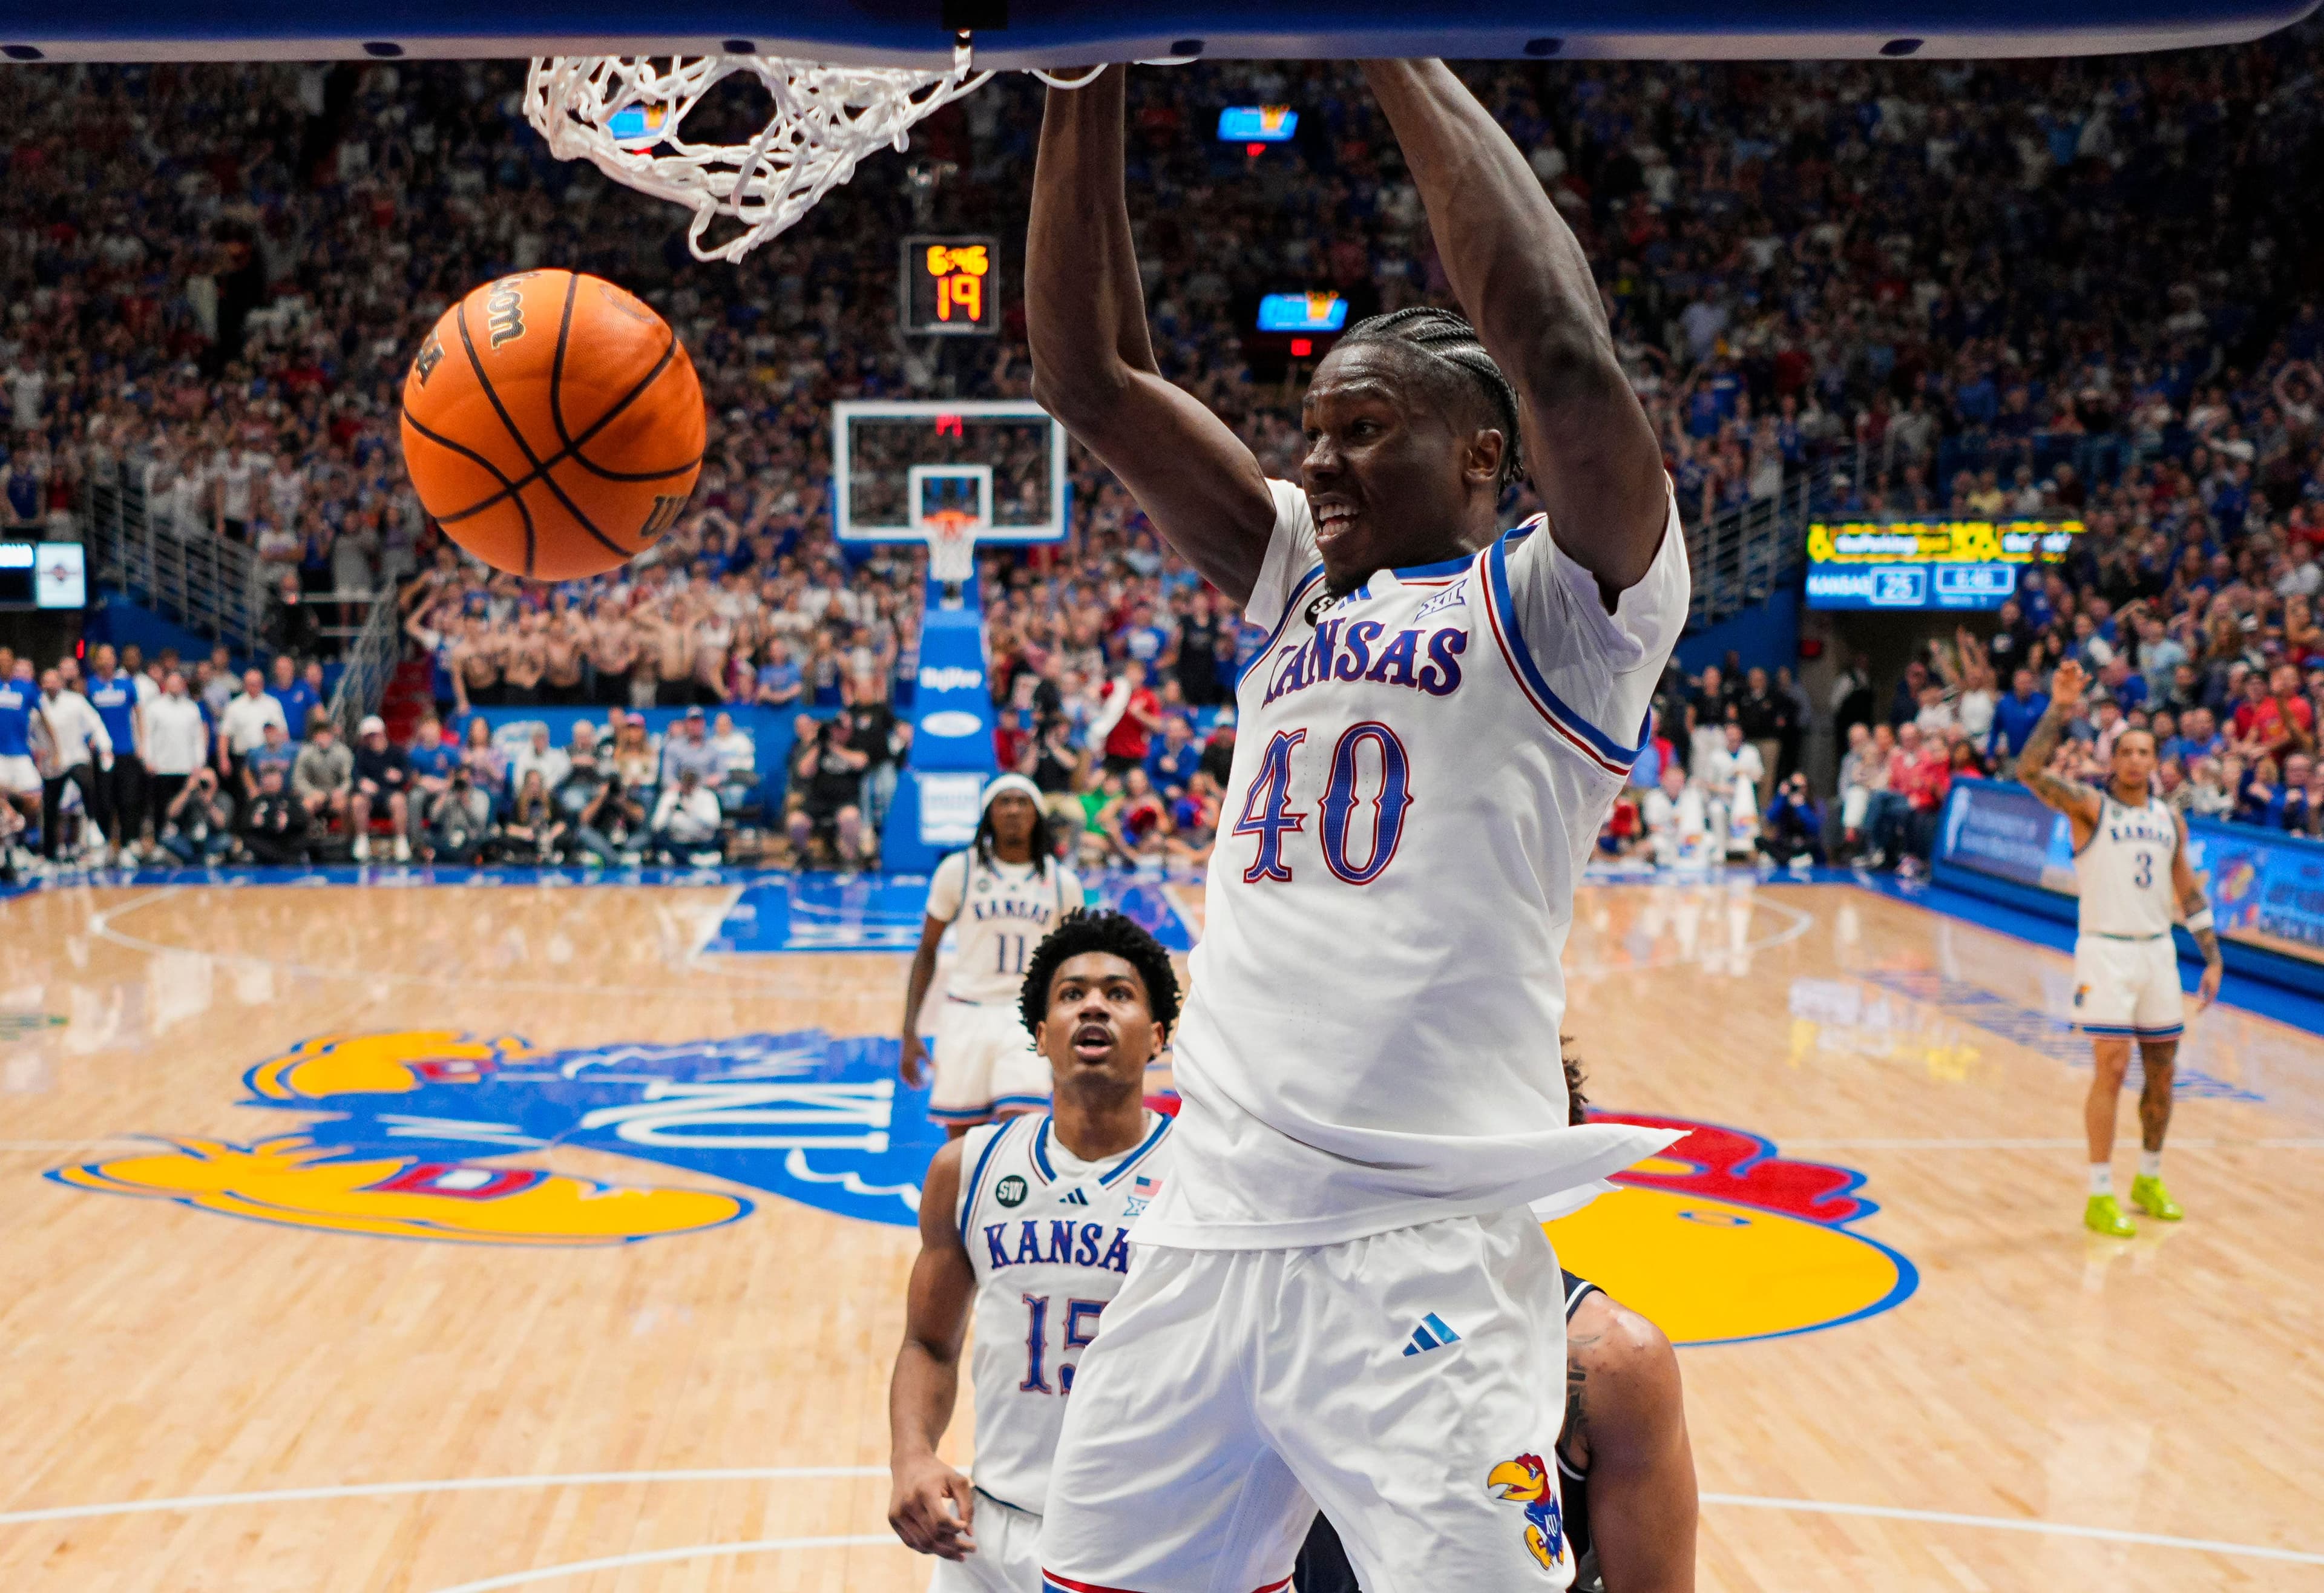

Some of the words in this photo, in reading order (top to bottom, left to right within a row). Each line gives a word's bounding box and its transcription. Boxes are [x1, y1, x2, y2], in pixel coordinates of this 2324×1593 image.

[937, 275, 981, 321] 19
[1882, 572, 1913, 600] 25
[1232, 721, 1414, 885] 40
[2134, 850, 2153, 888] 3
[997, 933, 1026, 976] 11
[998, 1180, 1025, 1203] SW
[984, 1218, 1129, 1275] KANSA
